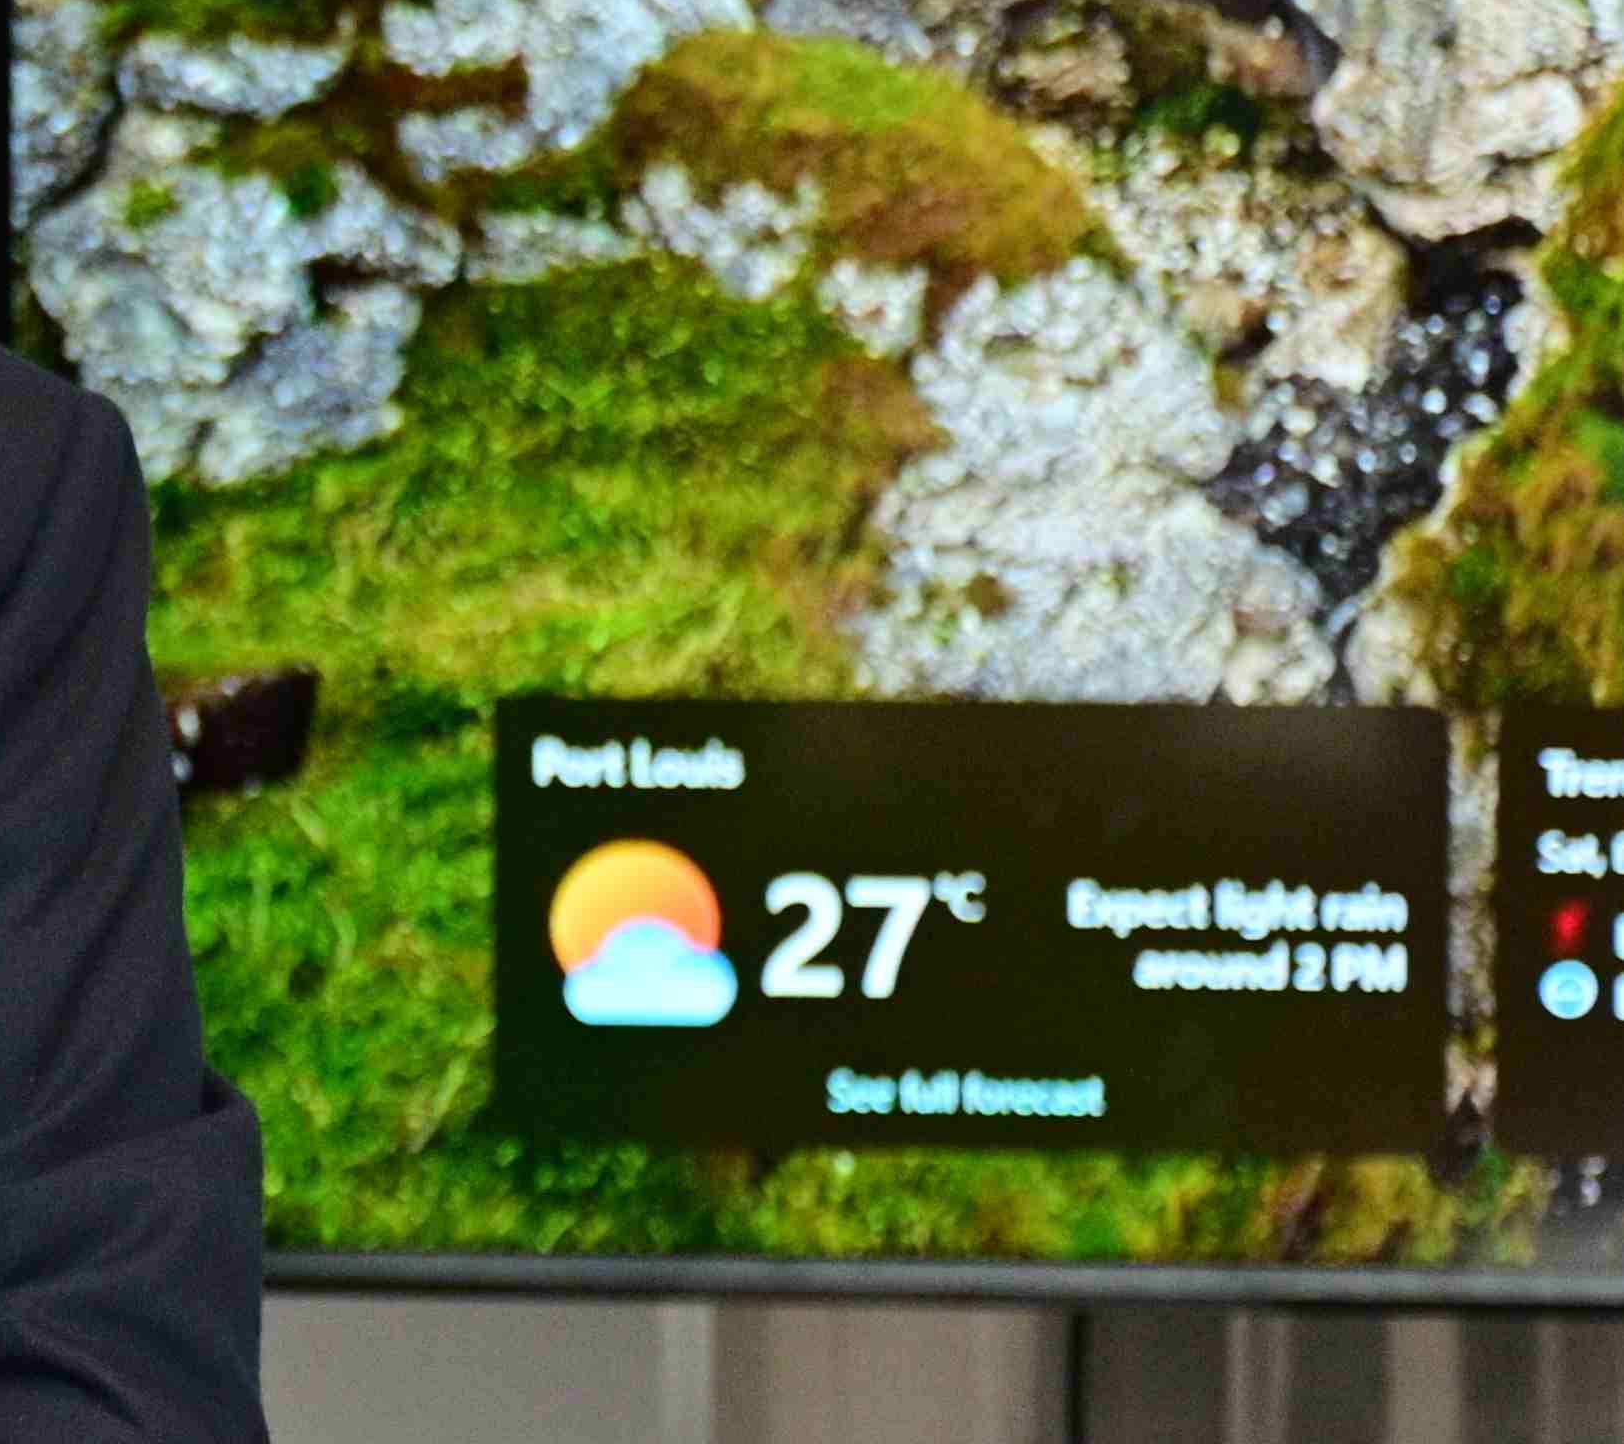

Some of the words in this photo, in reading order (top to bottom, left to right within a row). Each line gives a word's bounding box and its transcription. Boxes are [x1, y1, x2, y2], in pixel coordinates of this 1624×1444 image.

[532, 736, 626, 788] Port
[629, 738, 745, 790] Louis
[1066, 878, 1210, 939] Expect
[1214, 878, 1317, 940] light
[1320, 881, 1409, 933] rain
[1133, 939, 1290, 990] around
[1293, 943, 1326, 992] 2
[1331, 943, 1408, 992] PM
[827, 1066, 897, 1114] See
[900, 1067, 959, 1115] full
[962, 1068, 1107, 1117] forecast
